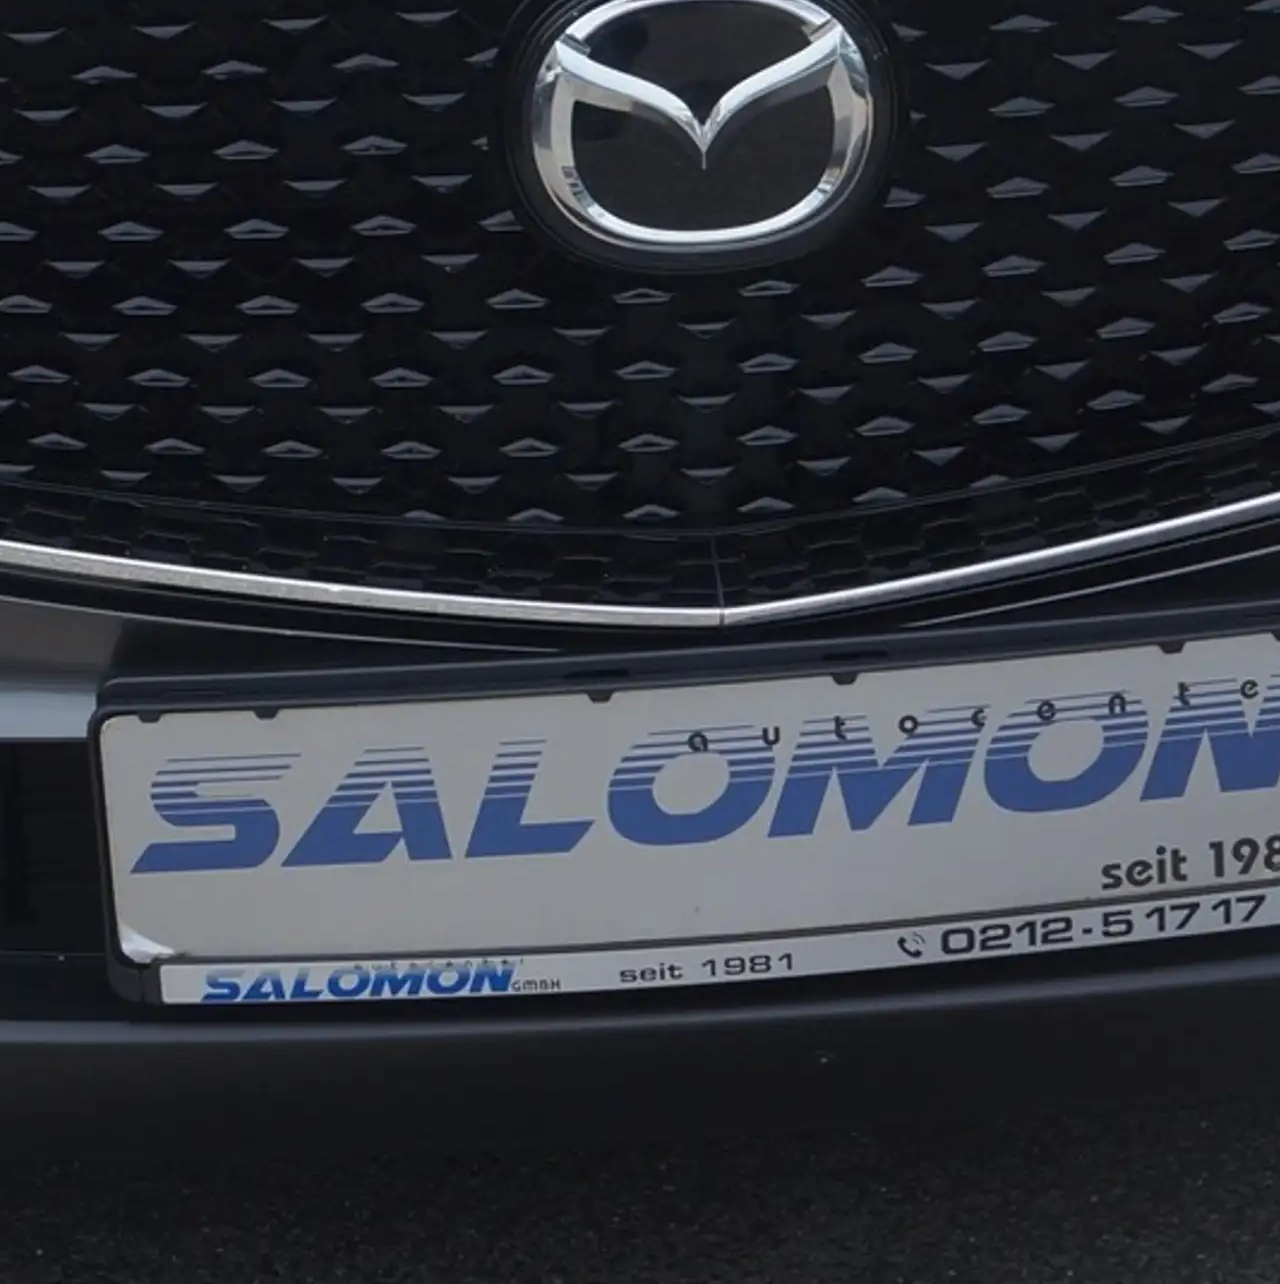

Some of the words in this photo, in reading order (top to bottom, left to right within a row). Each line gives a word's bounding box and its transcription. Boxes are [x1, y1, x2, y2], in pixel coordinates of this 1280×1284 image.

[1101, 845, 1188, 891] seit
[200, 963, 517, 1002] SALOMON
[619, 960, 684, 985] seit
[700, 952, 795, 977] 1981
